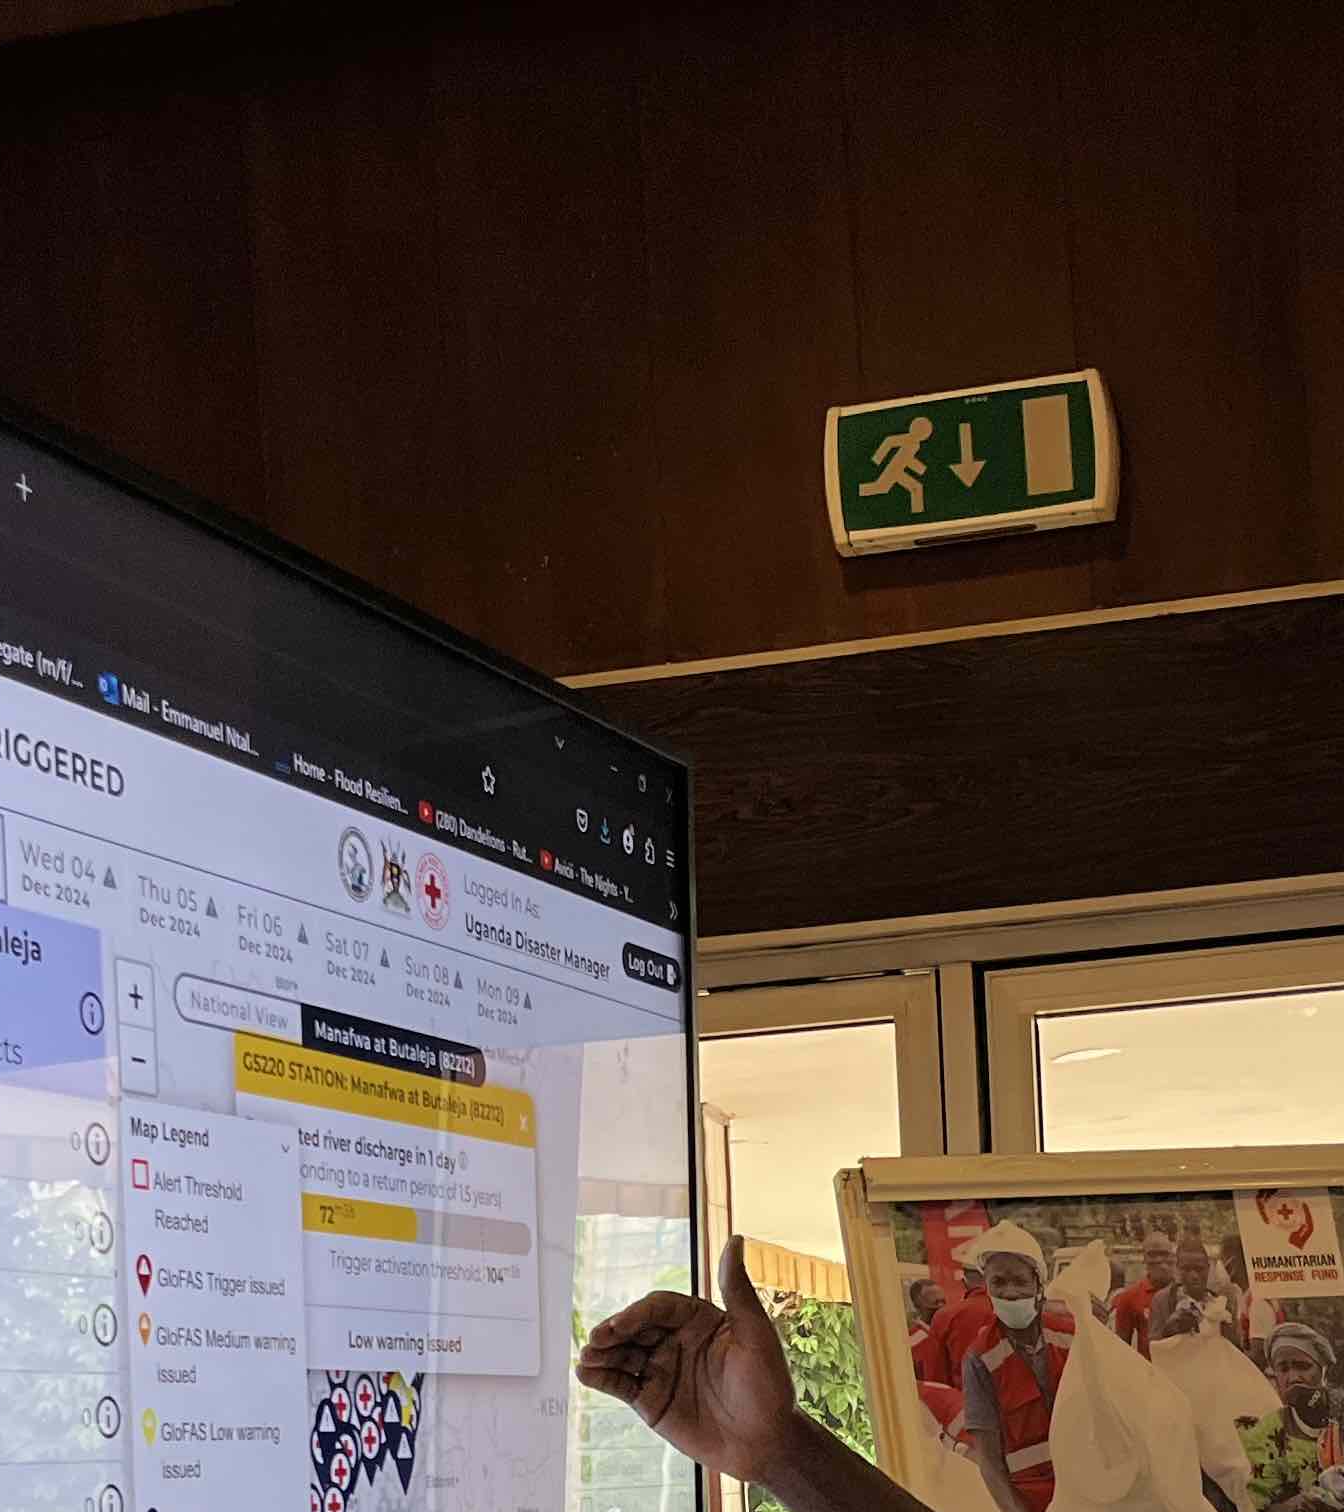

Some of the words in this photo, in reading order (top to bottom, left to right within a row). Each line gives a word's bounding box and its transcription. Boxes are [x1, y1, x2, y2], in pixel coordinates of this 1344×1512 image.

[19, 840, 64, 873] Wed
[71, 860, 96, 884] 04
[22, 875, 52, 897] Dec
[55, 884, 91, 908] 2024
[465, 913, 512, 946] Uganda
[515, 933, 561, 961] Disaster
[564, 950, 610, 982] Manager
[628, 952, 645, 977] Log
[647, 962, 664, 979] Out
[191, 991, 251, 1021] National
[257, 1003, 289, 1030] View
[314, 1020, 370, 1051] Manafwa
[374, 1034, 386, 1055] at
[389, 1037, 436, 1067] Butaleja
[130, 1117, 158, 1140] Map
[163, 1118, 209, 1148] Legend
[322, 1129, 352, 1152] river
[355, 1135, 413, 1166] discharge
[155, 1210, 208, 1233] Reached
[319, 1206, 336, 1225] 72
[1252, 1254, 1336, 1268] HUMANITARIAN
[1255, 1271, 1304, 1281] RESPONSE
[1312, 1269, 1338, 1280] FUND
[158, 1267, 204, 1291] GloFAS
[208, 1272, 247, 1295] Trigger
[250, 1277, 285, 1296] issued
[348, 1330, 373, 1349] Low
[376, 1335, 425, 1354] warning
[427, 1333, 461, 1352] issued
